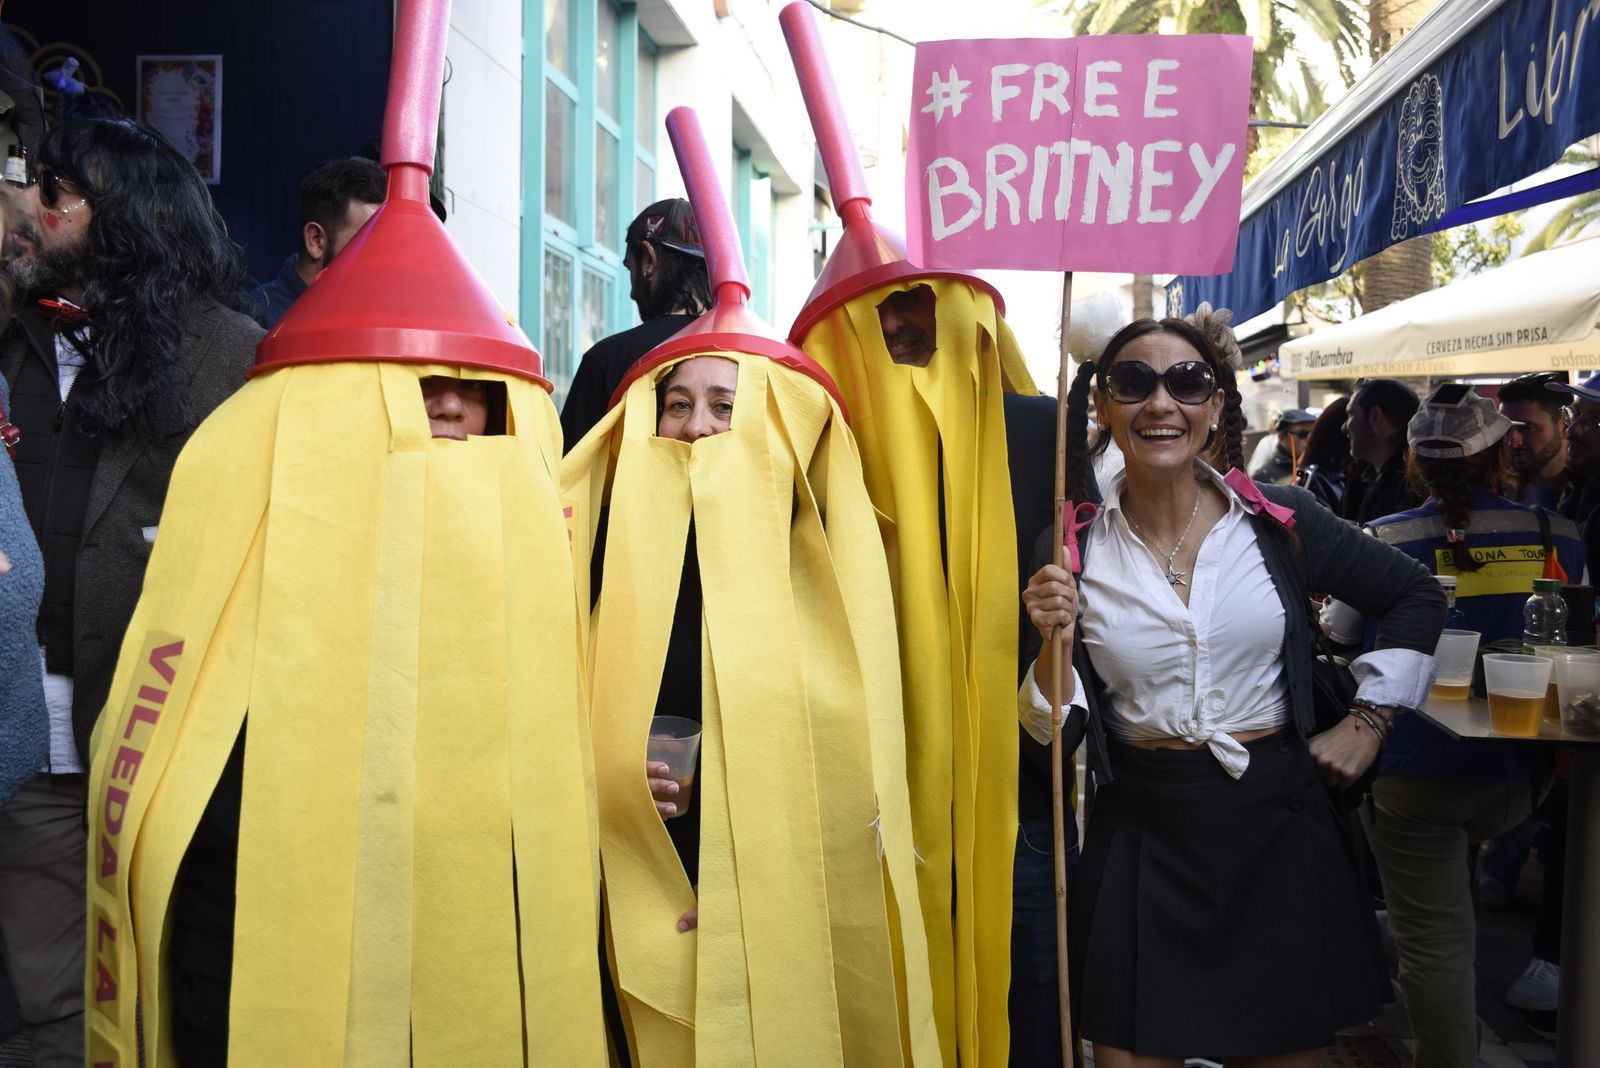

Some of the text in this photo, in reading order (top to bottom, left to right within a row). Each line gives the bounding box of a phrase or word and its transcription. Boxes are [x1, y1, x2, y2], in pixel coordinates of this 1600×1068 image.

[924, 137, 1236, 241] BRITNEY
[1272, 199, 1290, 279] La
[1305, 347, 1353, 369] Alhambra
[1426, 326, 1547, 355] CERVEZA HECHA SIN PRISA
[96, 640, 185, 1002] VILEDA LA
